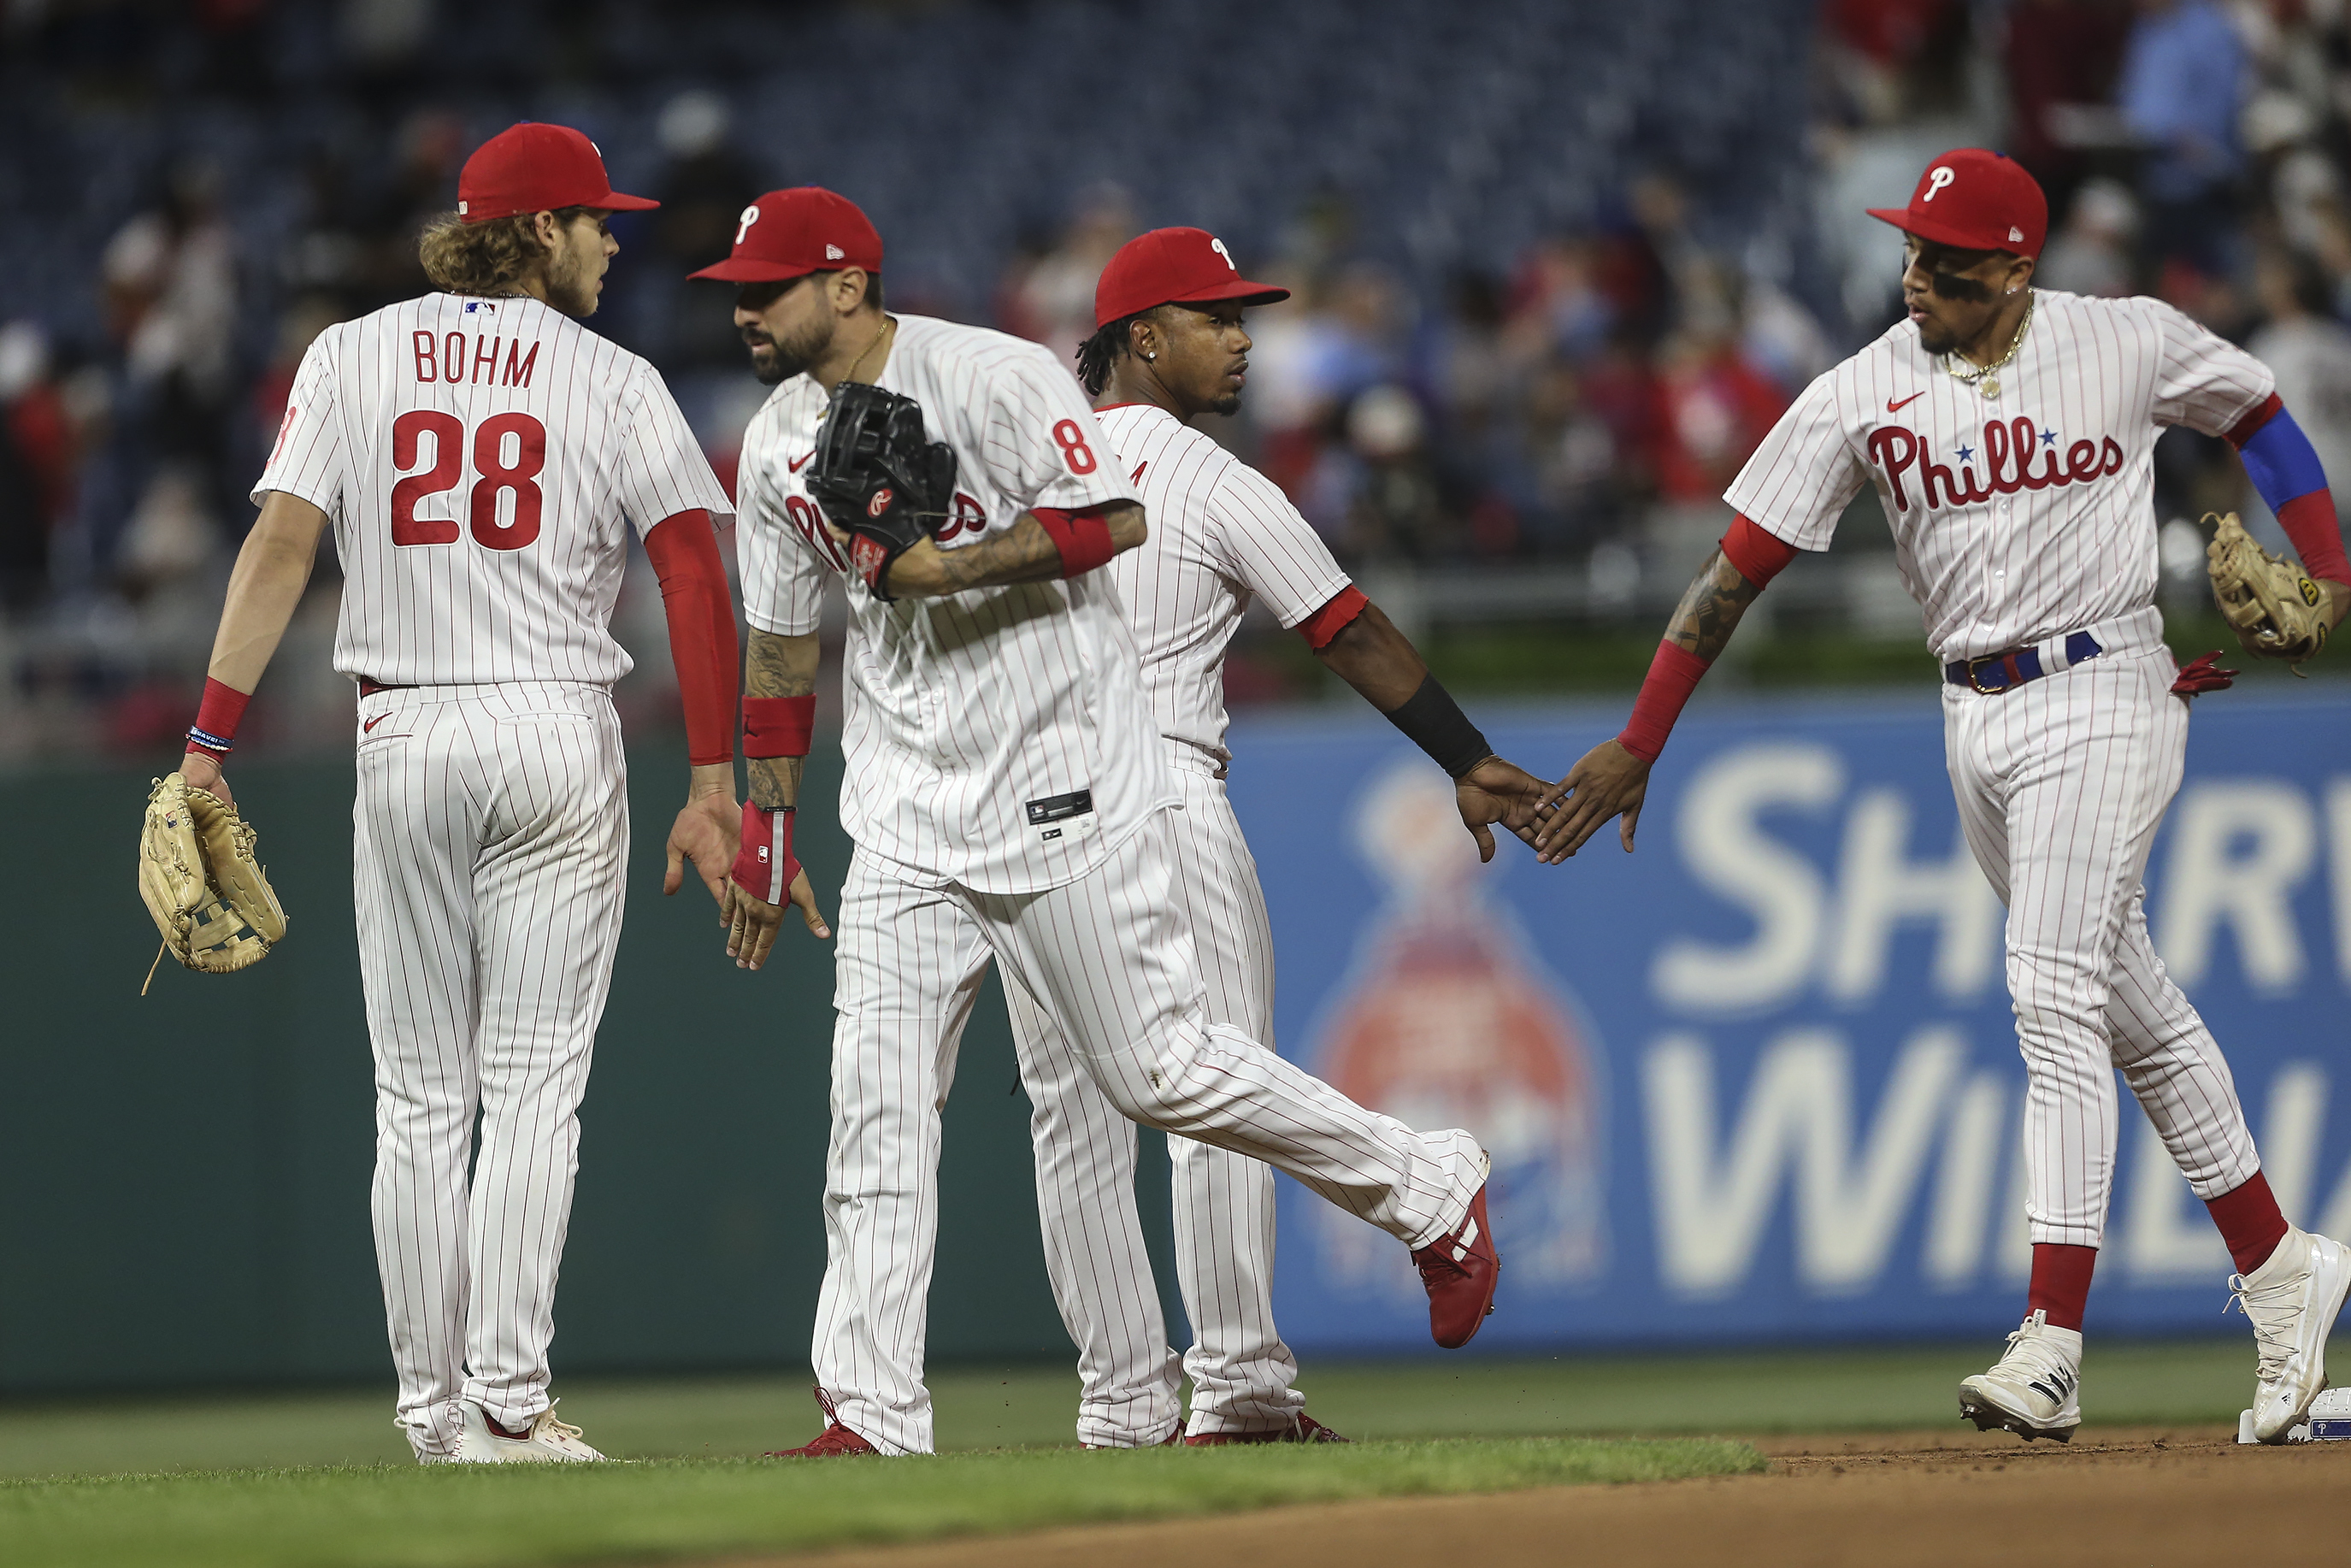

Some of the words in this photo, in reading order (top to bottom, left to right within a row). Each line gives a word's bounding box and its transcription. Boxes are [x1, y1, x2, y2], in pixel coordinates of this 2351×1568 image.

[1923, 165, 1956, 203] P
[735, 205, 760, 245] P
[1211, 237, 1236, 271] P
[413, 330, 540, 389] BOHM
[1052, 418, 1098, 476] 8
[1867, 416, 2124, 513] Phillies
[391, 409, 547, 551] 28
